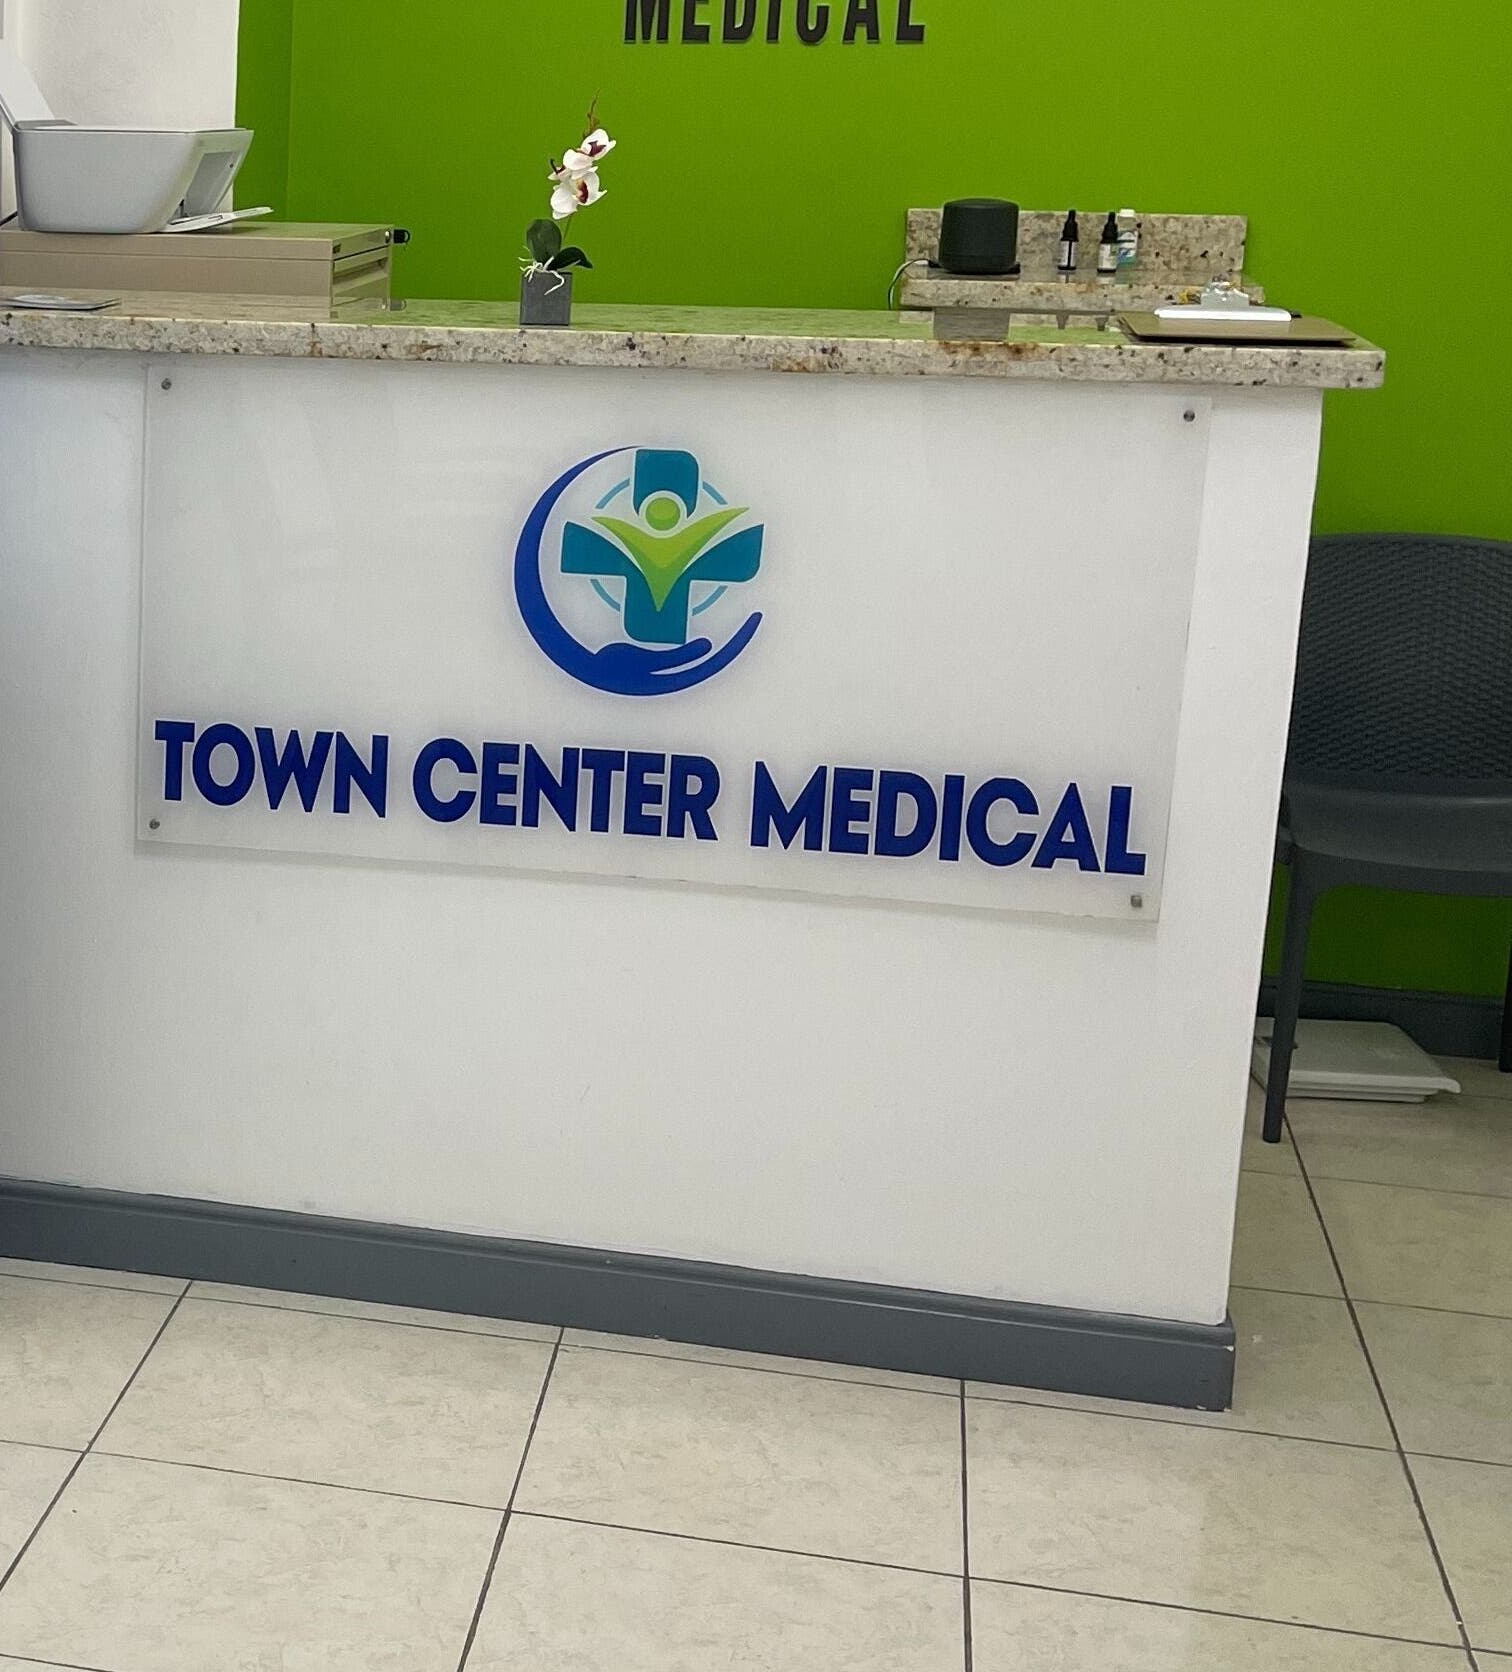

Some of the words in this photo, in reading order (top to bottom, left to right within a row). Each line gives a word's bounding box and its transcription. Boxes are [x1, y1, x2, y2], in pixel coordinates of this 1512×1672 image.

[155, 720, 388, 818] TOWN
[413, 738, 720, 841] CENTER
[750, 761, 1146, 876] MEDICAL
